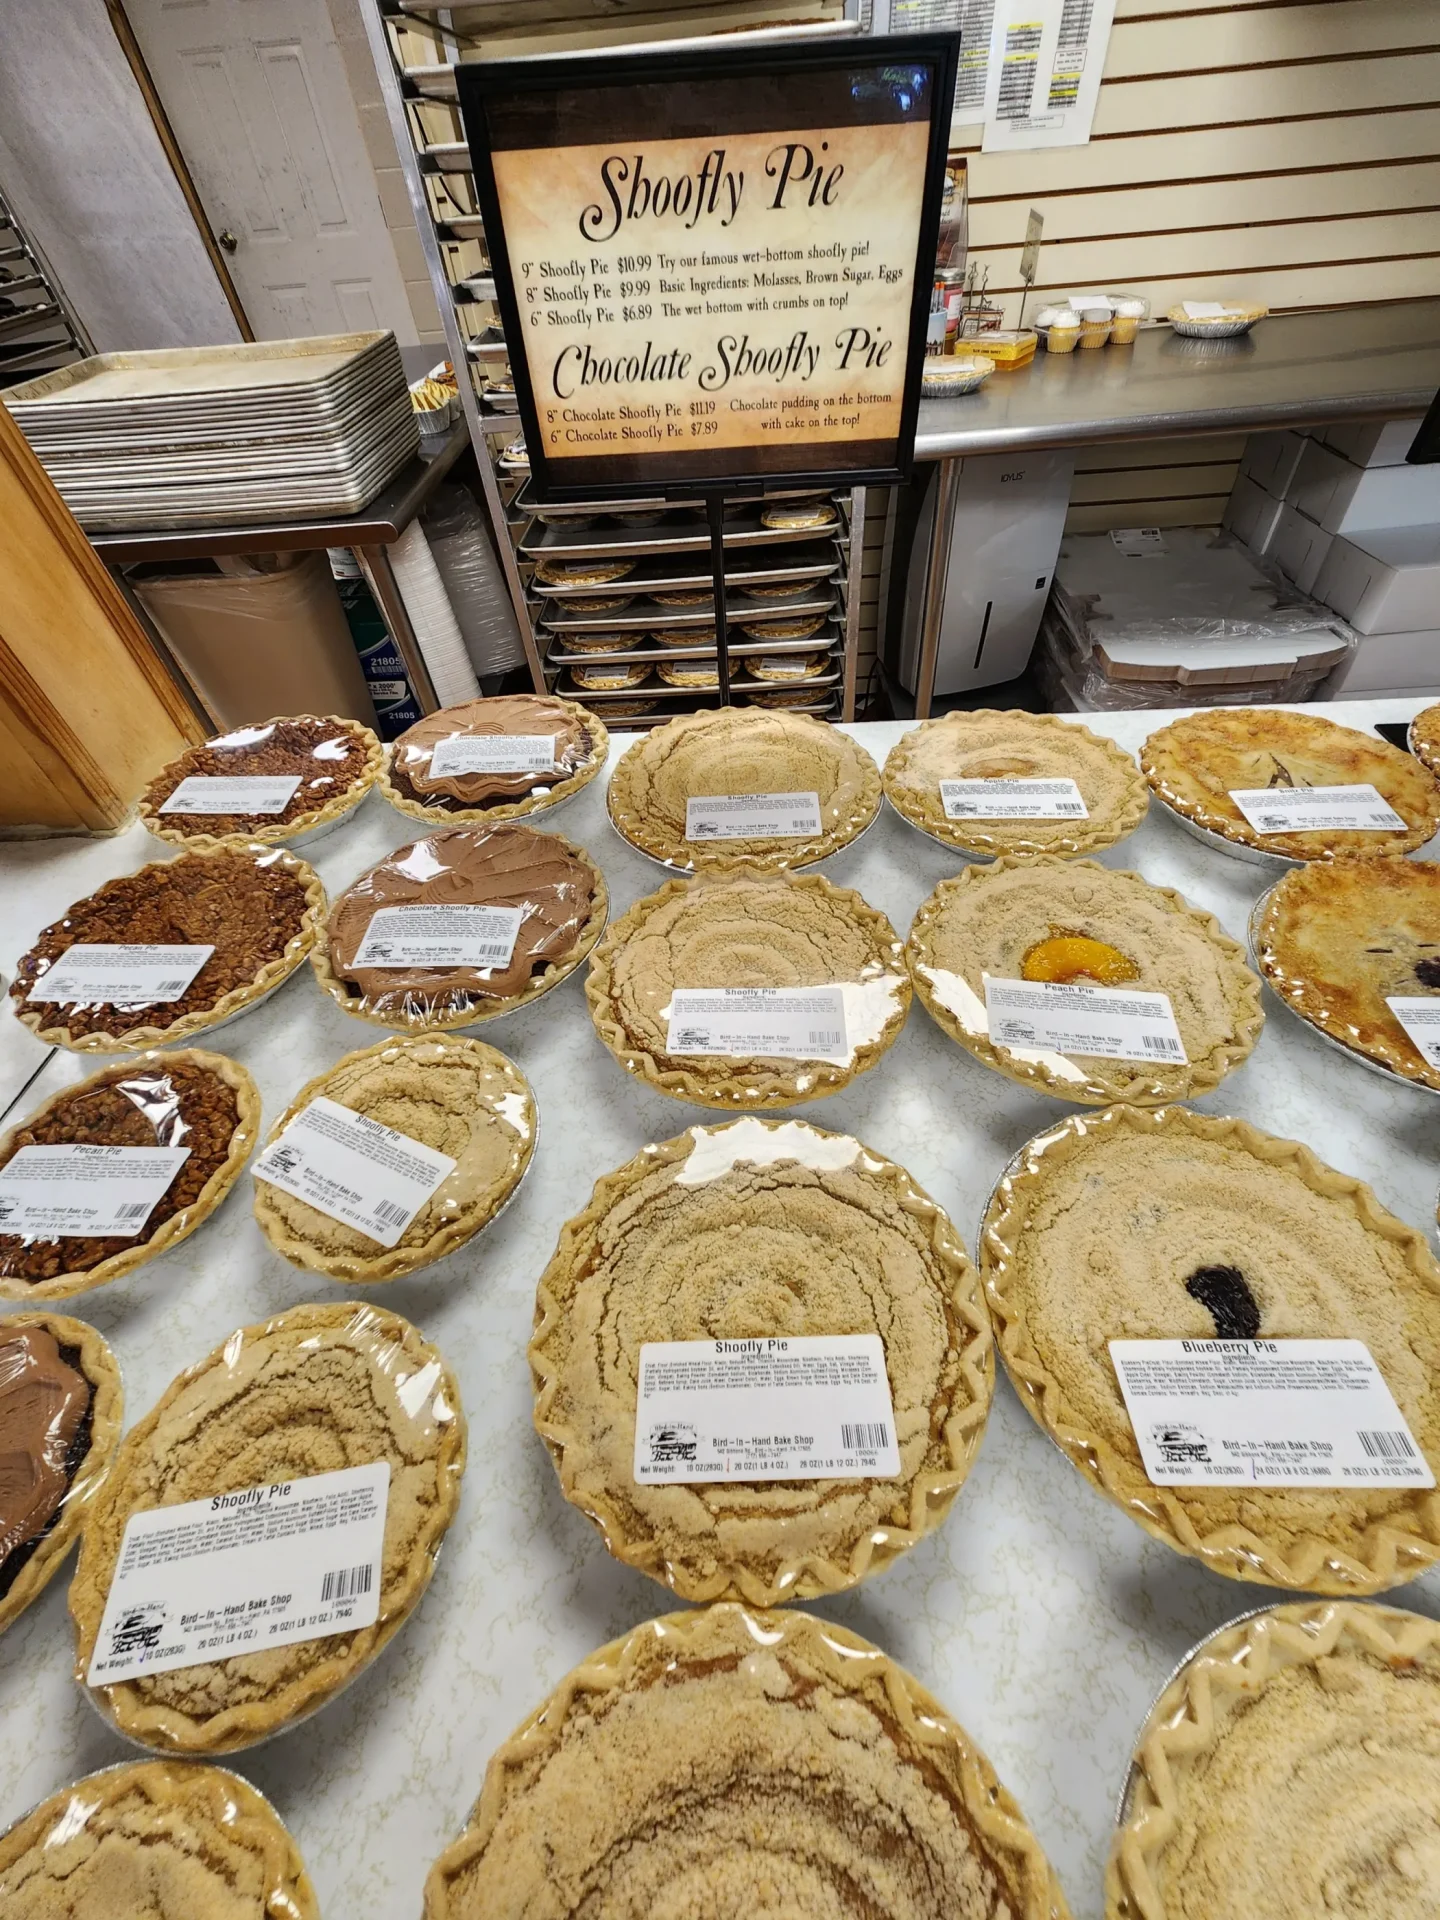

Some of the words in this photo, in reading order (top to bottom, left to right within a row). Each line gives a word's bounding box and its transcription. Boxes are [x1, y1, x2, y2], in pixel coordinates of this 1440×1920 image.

[579, 150, 744, 242] Shoofly
[765, 142, 844, 209] Pie
[657, 254, 675, 274] Try
[680, 256, 697, 268] our
[702, 250, 738, 266] famous
[743, 247, 804, 264] wet-bottom
[808, 242, 847, 262] shoofly
[851, 240, 870, 262] pie!
[540, 259, 586, 282] Shoofly
[591, 258, 609, 275] Pie
[617, 255, 652, 275] $10.99
[659, 278, 685, 294] Basic
[690, 274, 750, 296] Ingredients:
[806, 270, 838, 285] Brown
[878, 263, 903, 284] Eggs
[543, 285, 589, 306] Shoofly
[594, 283, 611, 299] Pie
[620, 279, 650, 299] $9.99
[661, 302, 681, 318] The
[685, 304, 702, 315] wet
[706, 301, 743, 314] bottom
[747, 297, 769, 312] with
[772, 295, 809, 310] crumbs
[813, 297, 825, 307] on
[829, 292, 849, 311] top!
[547, 309, 592, 330] Shoofly
[596, 307, 614, 323] Pie
[623, 304, 653, 323] $6.89
[553, 341, 692, 399] Chocolate
[698, 331, 820, 392] Shoofly
[834, 326, 892, 371] Pie
[730, 397, 778, 412] Chocolate
[781, 395, 820, 413] pudding
[823, 396, 835, 406] on
[839, 393, 854, 405] the
[857, 392, 892, 404] bottom
[562, 408, 616, 423] Chocolate
[619, 404, 661, 423] Shoofly
[665, 403, 682, 417] Pie
[689, 401, 716, 416] $11.19
[761, 417, 782, 430] with
[785, 416, 805, 429] cake
[808, 418, 820, 428] on
[823, 414, 838, 426] the
[842, 413, 860, 429] top!
[566, 428, 618, 443] Chocolate
[621, 425, 663, 443] Shoofly
[667, 423, 683, 437] Pie
[691, 421, 718, 437] $7.89
[398, 905, 437, 913] Chocolate
[439, 904, 470, 912] Shoofly
[725, 988, 758, 996] Shoofly
[1044, 983, 1075, 993] Peach
[1078, 985, 1095, 995] Pie
[355, 1115, 387, 1138] Shoofly
[386, 1128, 401, 1142] Pie
[72, 1145, 103, 1155] Pecan
[106, 1147, 122, 1155] Pie
[716, 1340, 763, 1354] Shoofly
[768, 1339, 788, 1351] Pie
[1181, 1340, 1249, 1355] Blueberry
[1253, 1340, 1278, 1353] Pie
[774, 1436, 791, 1445] Bake
[794, 1435, 814, 1445] Shop
[1288, 1441, 1309, 1450] Bake
[1310, 1441, 1333, 1451] Shop
[640, 1465, 651, 1473] Net
[734, 1463, 742, 1471] 20
[760, 1461, 767, 1470] LB
[770, 1461, 775, 1469] 4
[800, 1460, 807, 1469] 28
[826, 1459, 833, 1467] LB
[836, 1459, 843, 1467] 12
[861, 1458, 876, 1467] 794G
[1155, 1466, 1166, 1474] Net
[211, 1489, 264, 1511] Shoofly
[269, 1484, 292, 1499] Pie
[248, 1598, 268, 1611] Bake
[270, 1593, 292, 1607] Shop
[297, 1617, 306, 1628] LB
[309, 1616, 317, 1625] 12
[226, 1633, 235, 1644] LB
[95, 1661, 107, 1672] Net
